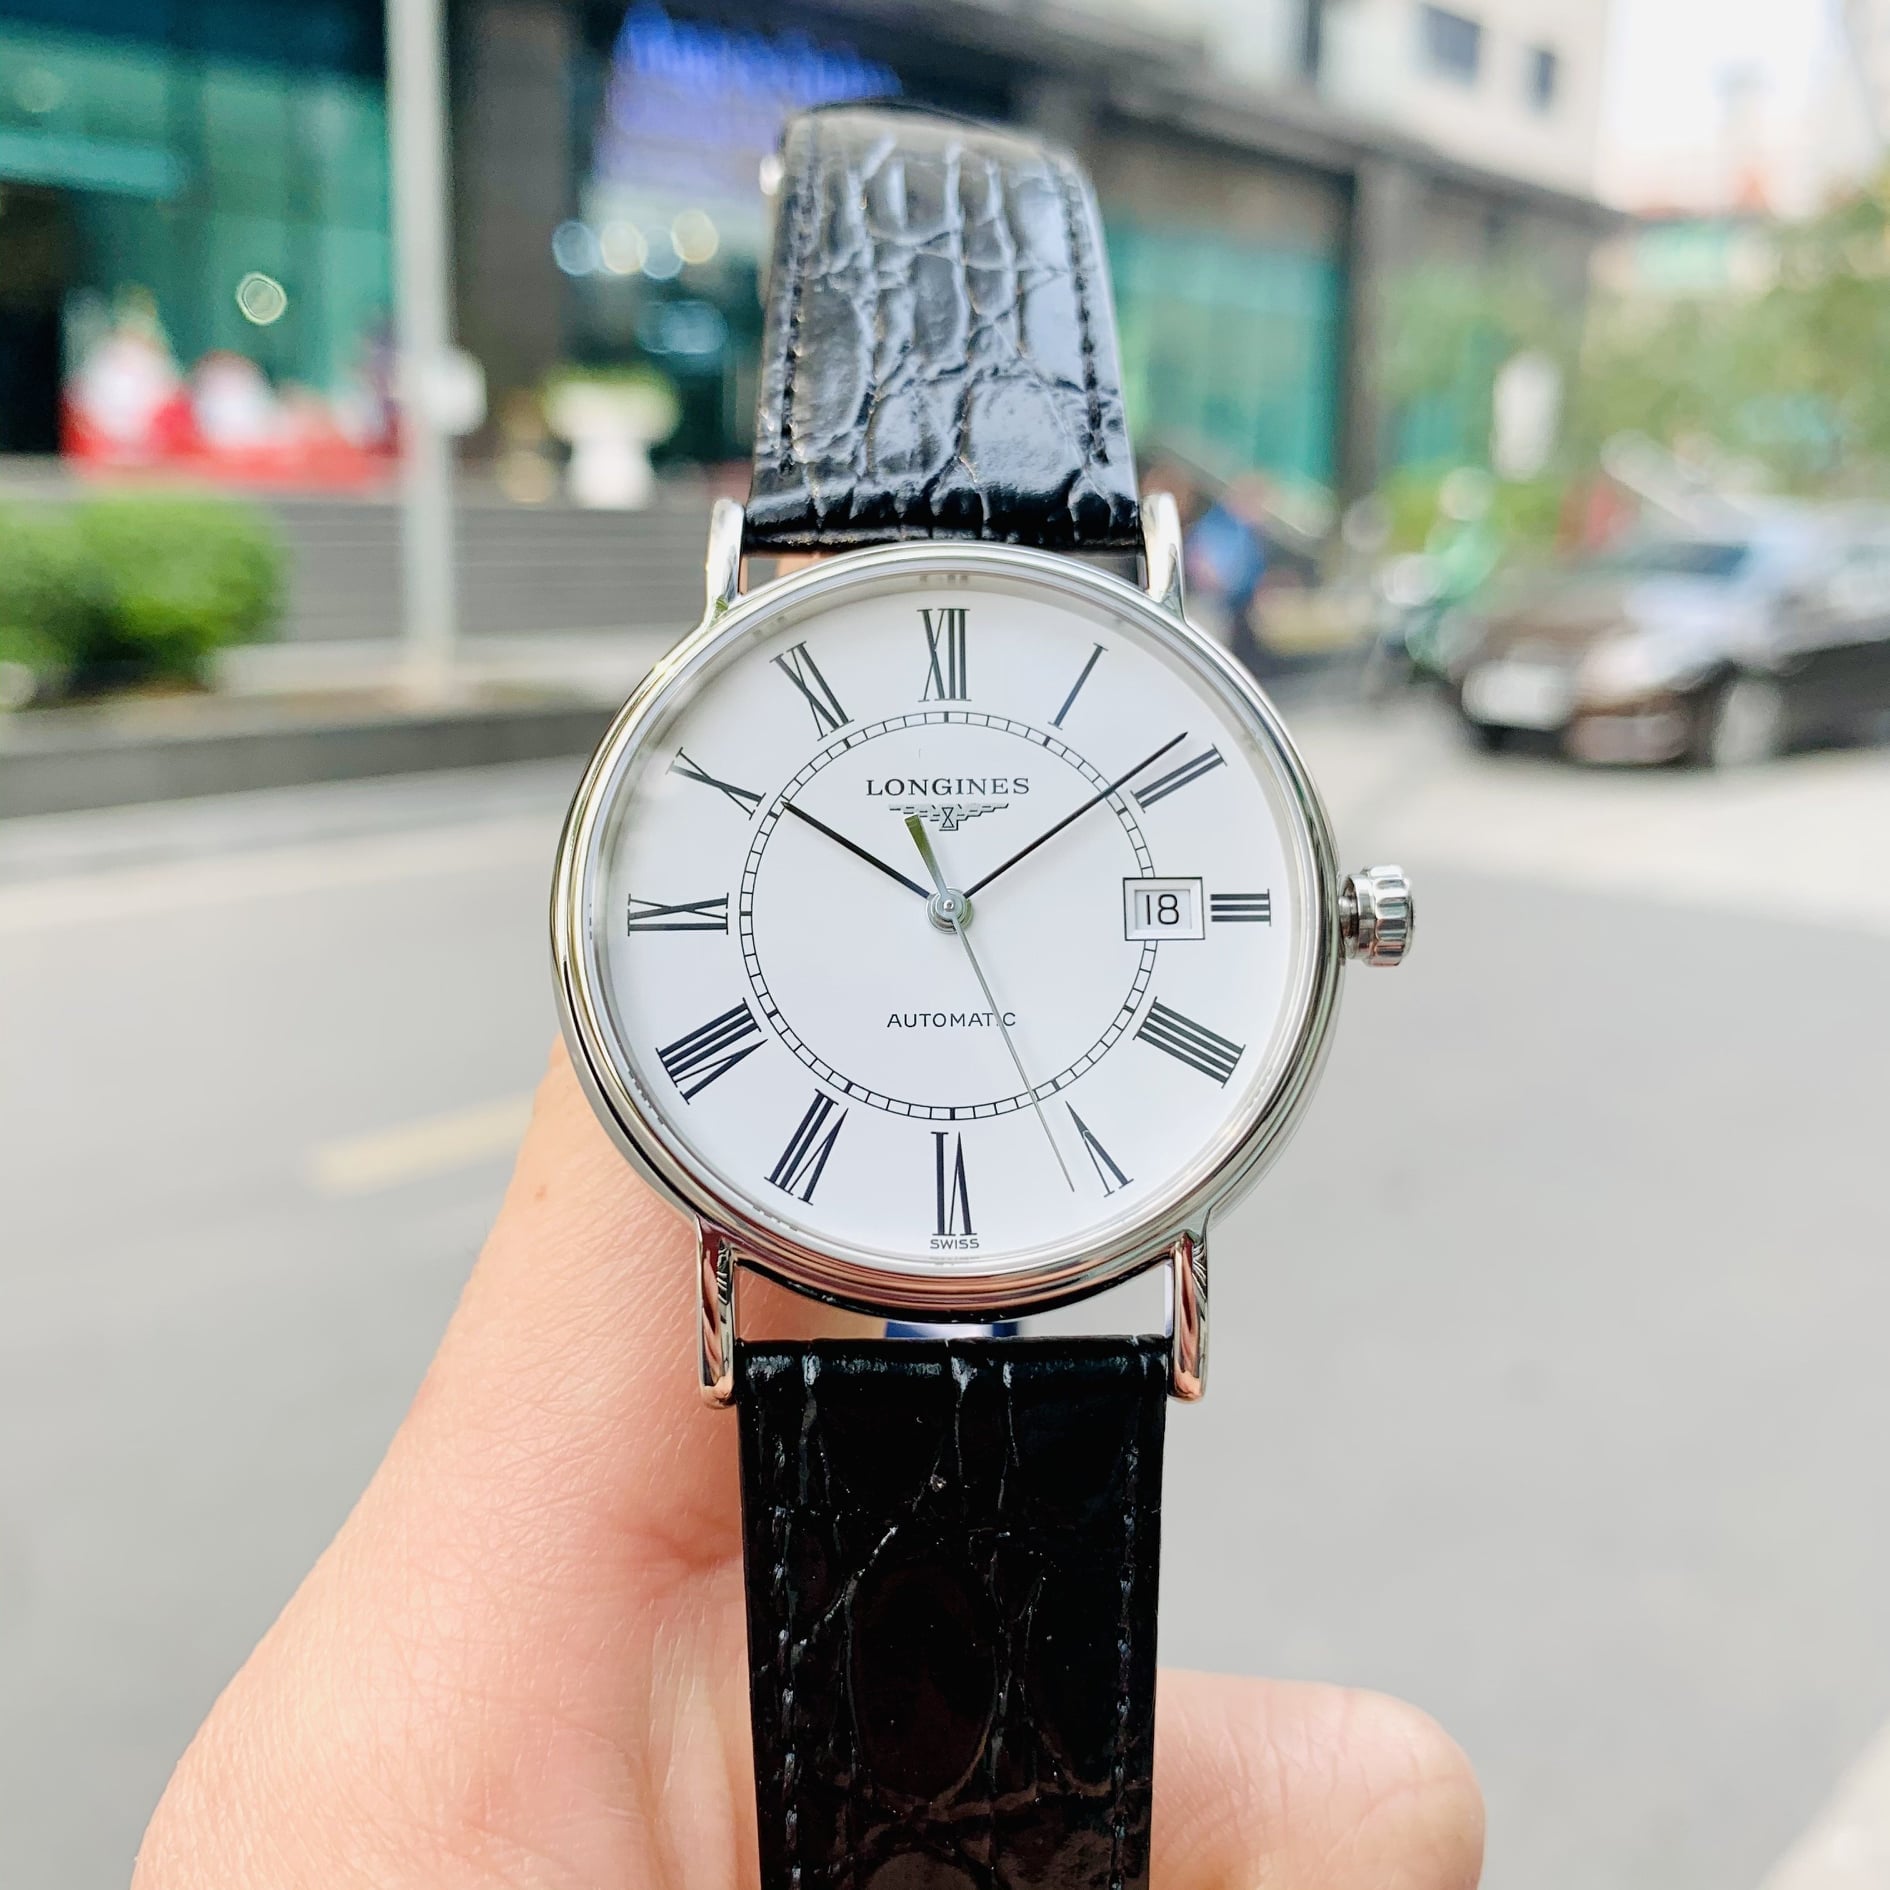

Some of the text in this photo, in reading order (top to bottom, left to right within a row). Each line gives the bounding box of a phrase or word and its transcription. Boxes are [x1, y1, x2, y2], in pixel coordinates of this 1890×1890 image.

[769, 641, 854, 741] XI
[917, 608, 971, 702] XII
[666, 747, 766, 820] X
[866, 777, 1030, 797] LONGINES
[1130, 743, 1227, 814] II
[1145, 894, 1180, 926] 18
[1210, 888, 1272, 927] III
[656, 997, 768, 1105] VIII
[887, 1012, 1016, 1028] AUTOMATC
[1132, 996, 1246, 1088] IIII
[764, 1088, 849, 1206] VII
[930, 1131, 978, 1237] VI
[1065, 1101, 1134, 1198] V
[929, 1238, 980, 1250] SWISS
